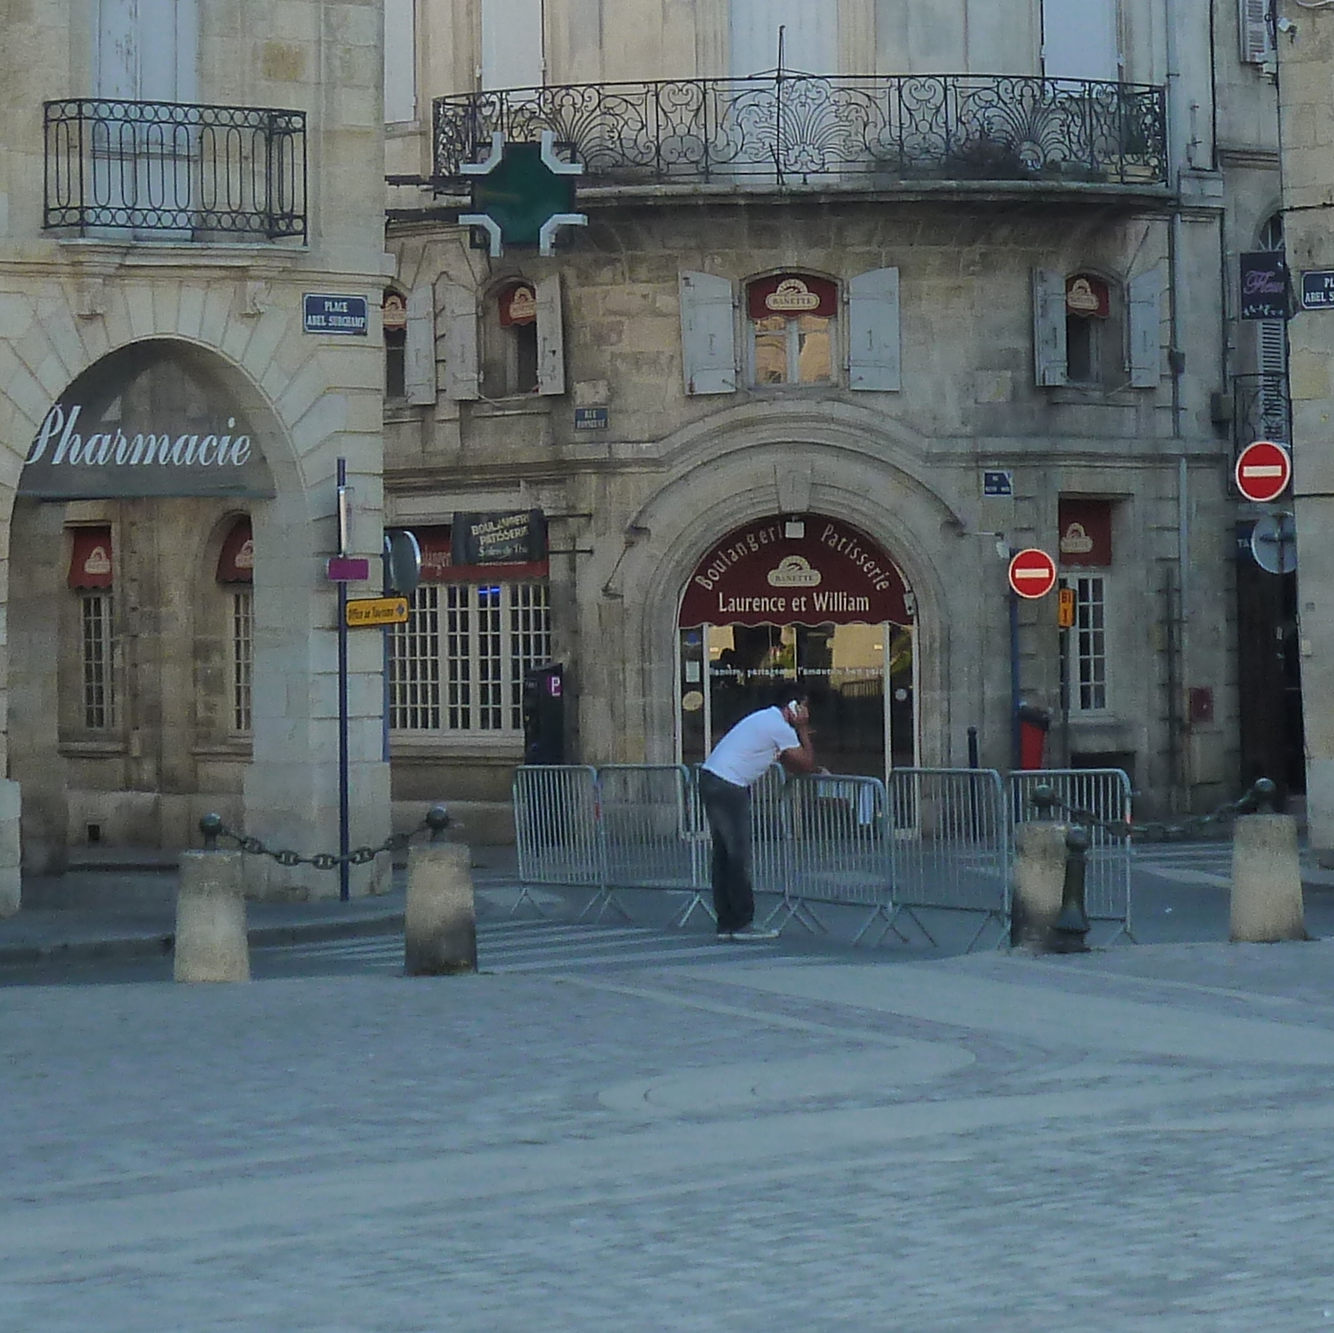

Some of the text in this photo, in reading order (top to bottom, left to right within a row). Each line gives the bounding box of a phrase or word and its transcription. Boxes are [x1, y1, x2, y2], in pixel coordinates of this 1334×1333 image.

[324, 301, 349, 313] PLACE
[1305, 292, 1327, 303] ABEL
[24, 403, 252, 467] Pharmacie
[471, 513, 530, 537] BOULANGERI
[695, 521, 784, 591] Boulangeri
[719, 592, 870, 613] Laurence et William
